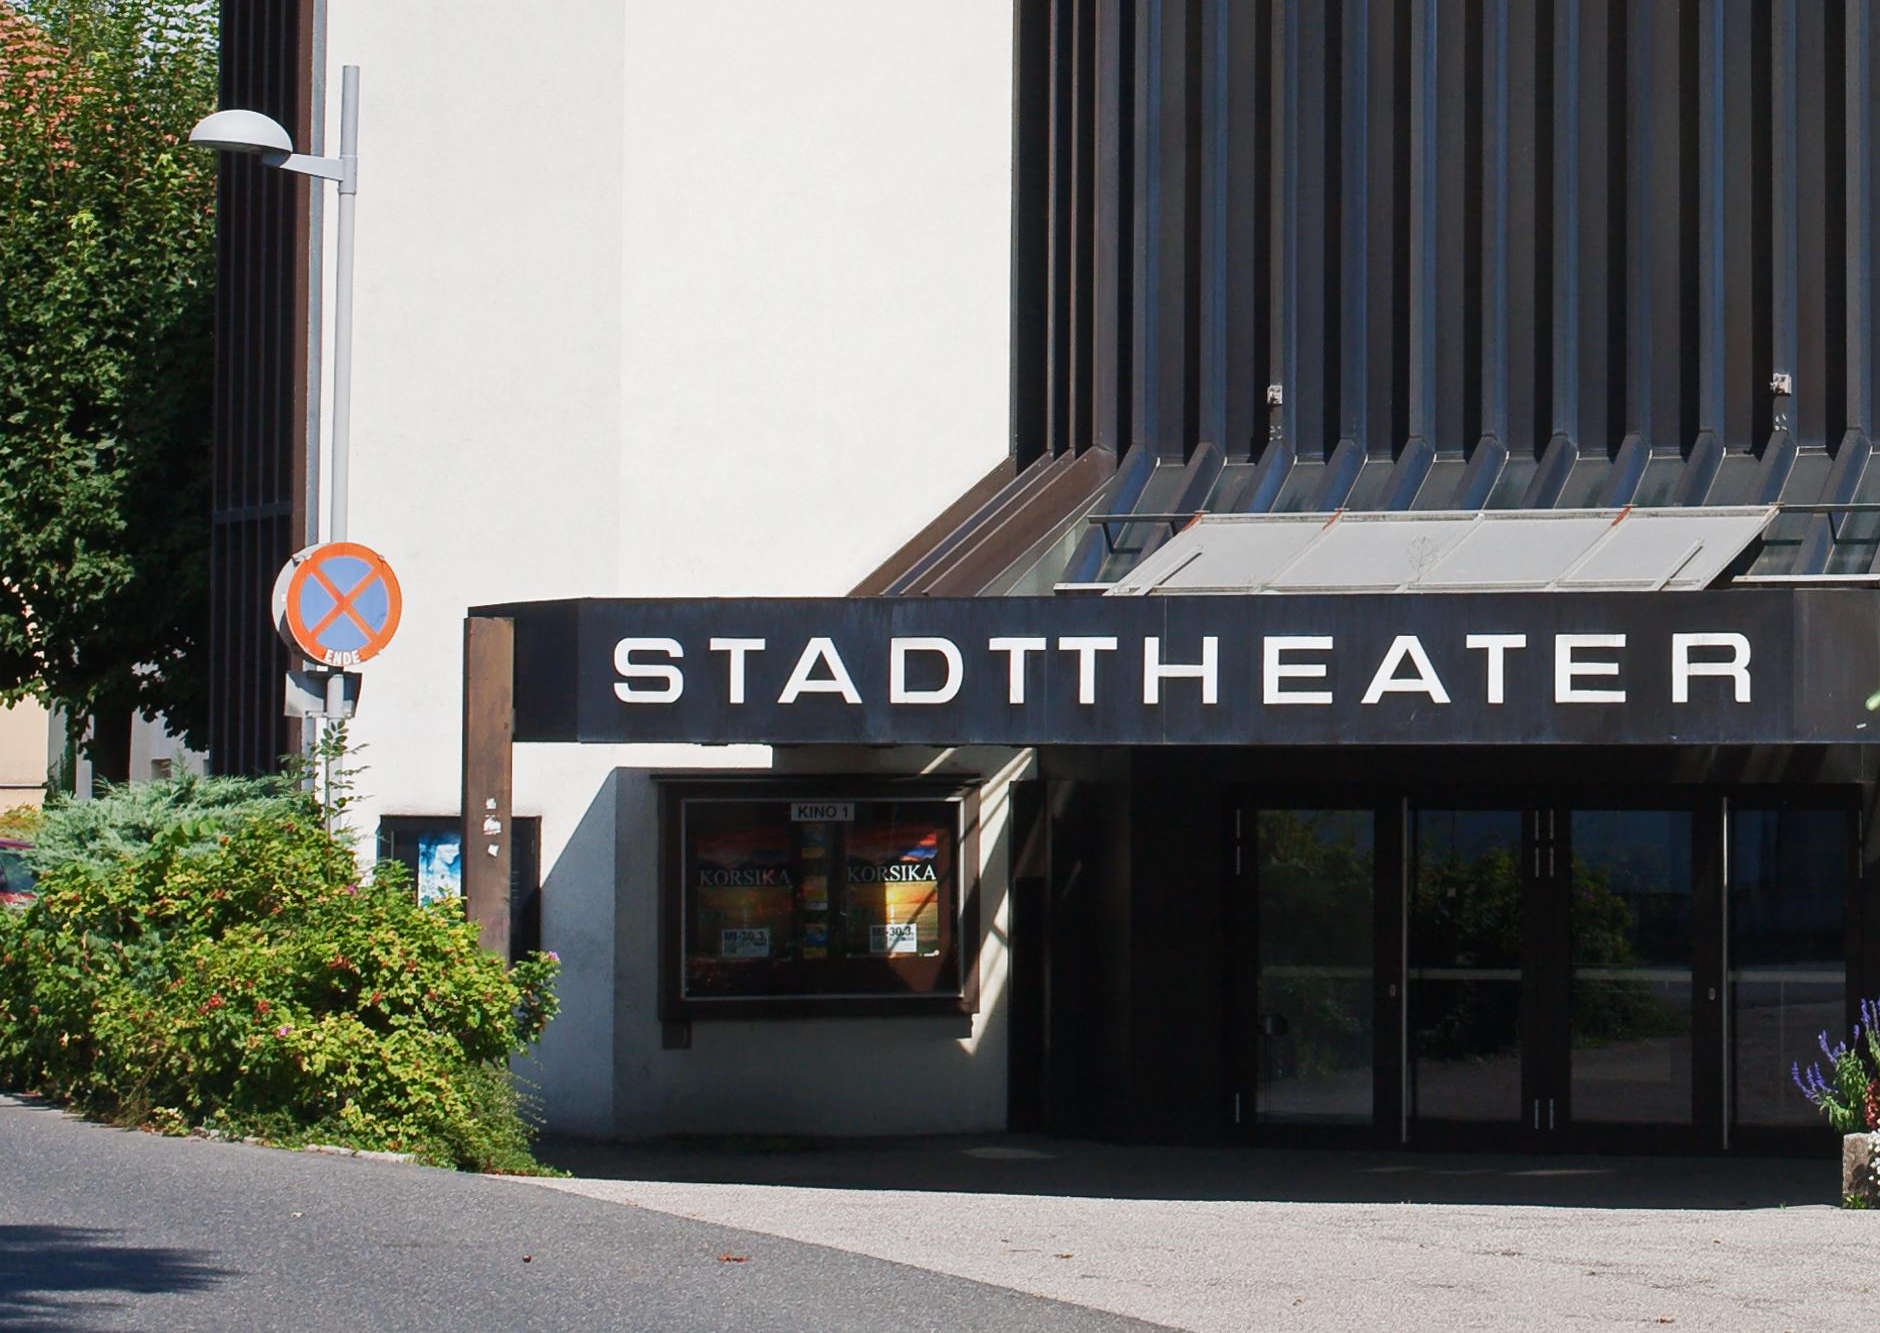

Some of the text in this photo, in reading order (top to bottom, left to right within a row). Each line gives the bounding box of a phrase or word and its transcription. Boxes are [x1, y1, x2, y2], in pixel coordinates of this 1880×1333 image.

[324, 649, 360, 665] ENDE
[612, 633, 1753, 705] STADTTHEATER
[797, 804, 850, 818] KINO 1
[699, 868, 791, 886] KORSIKA
[847, 864, 937, 882] KORSIKA
